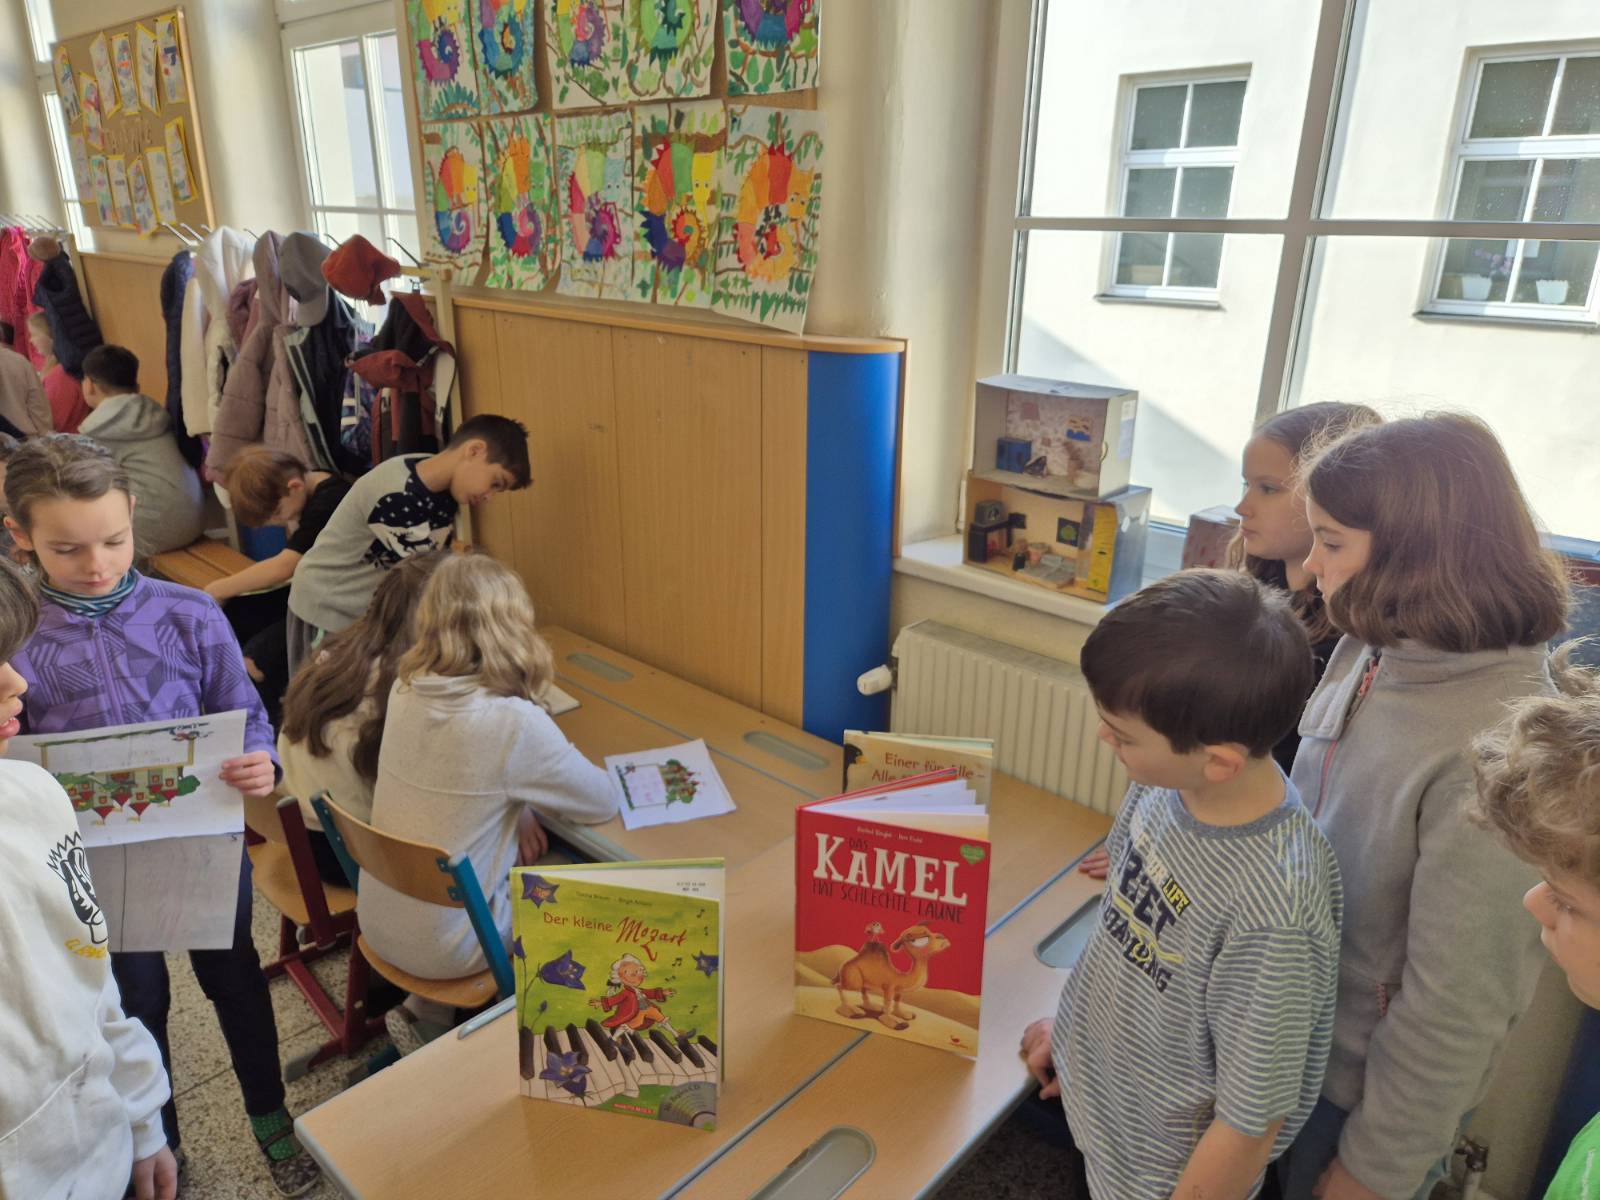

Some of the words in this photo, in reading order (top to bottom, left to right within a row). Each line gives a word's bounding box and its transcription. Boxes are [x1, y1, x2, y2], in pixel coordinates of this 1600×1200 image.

[885, 752, 919, 769] Einer
[871, 769, 897, 783] Alle
[813, 832, 968, 906] KAMEL
[917, 900, 966, 924] LAUNE
[543, 911, 569, 925] Der
[573, 915, 613, 933] kleine
[615, 916, 688, 962] Mozart
